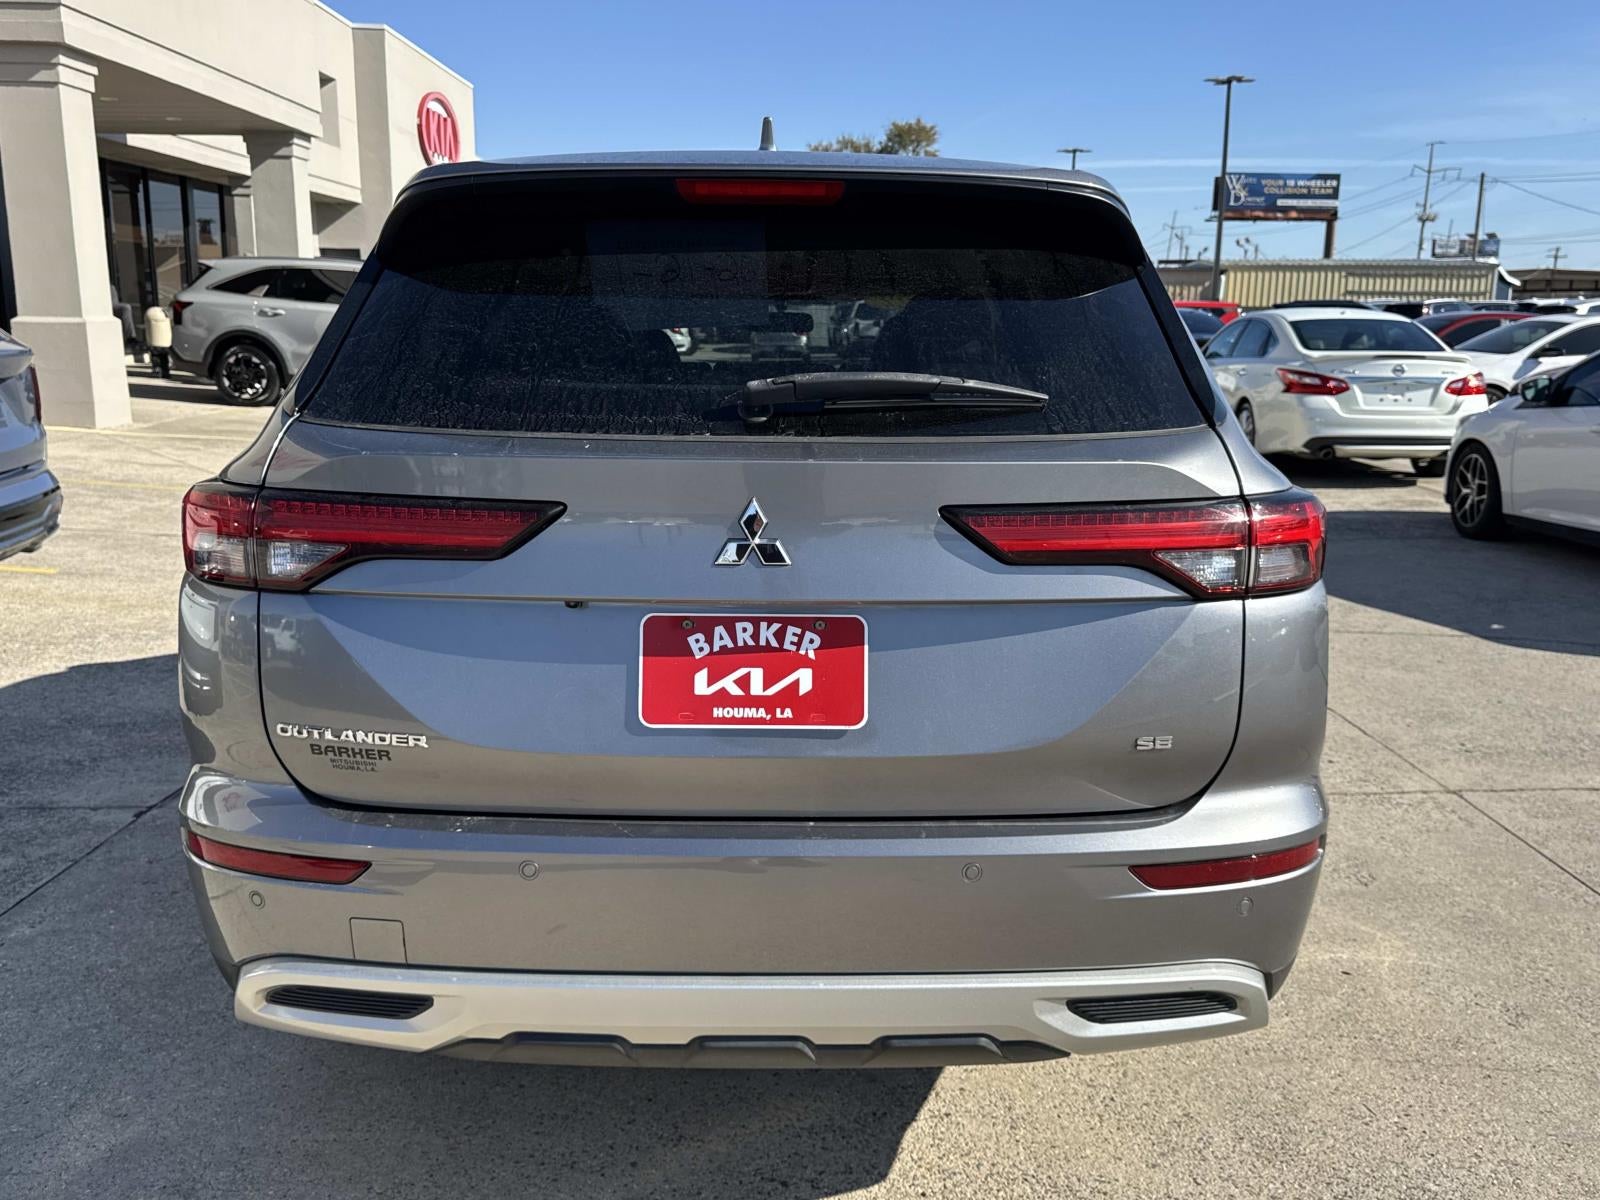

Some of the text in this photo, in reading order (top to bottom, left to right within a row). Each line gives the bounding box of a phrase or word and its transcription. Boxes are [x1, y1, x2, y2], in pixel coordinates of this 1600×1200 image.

[687, 621, 821, 660] BARKER
[713, 707, 793, 720] HOUMA, LA
[276, 722, 429, 749] OUTLANDER
[1136, 735, 1173, 751] SE
[309, 743, 392, 761] BARKER
[330, 757, 377, 767] MITSUBISHI
